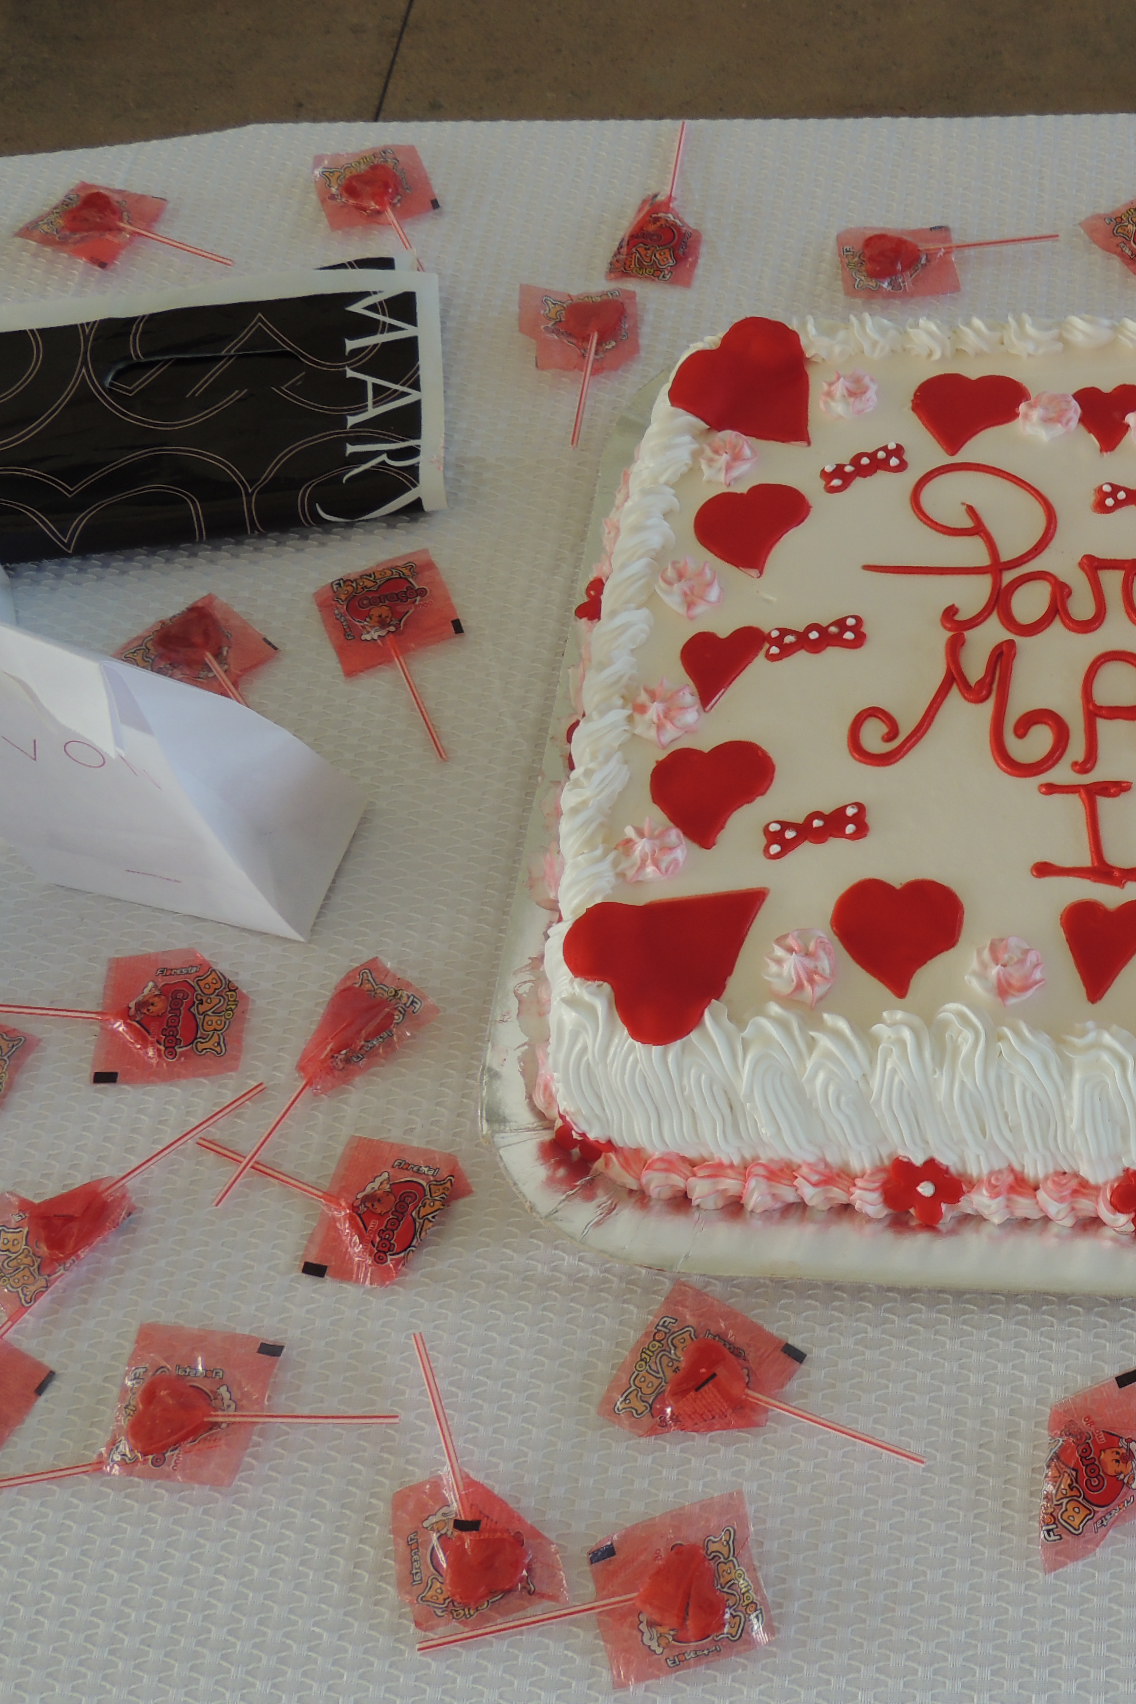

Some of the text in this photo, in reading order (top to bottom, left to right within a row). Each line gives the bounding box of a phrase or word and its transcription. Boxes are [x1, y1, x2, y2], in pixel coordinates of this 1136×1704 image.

[315, 290, 423, 522] MARY
[161, 989, 191, 1061] Coração
[193, 968, 228, 1058] BABY
[225, 976, 240, 1020] opito
[392, 1158, 441, 1177] Florestal
[372, 1190, 419, 1266] Coração
